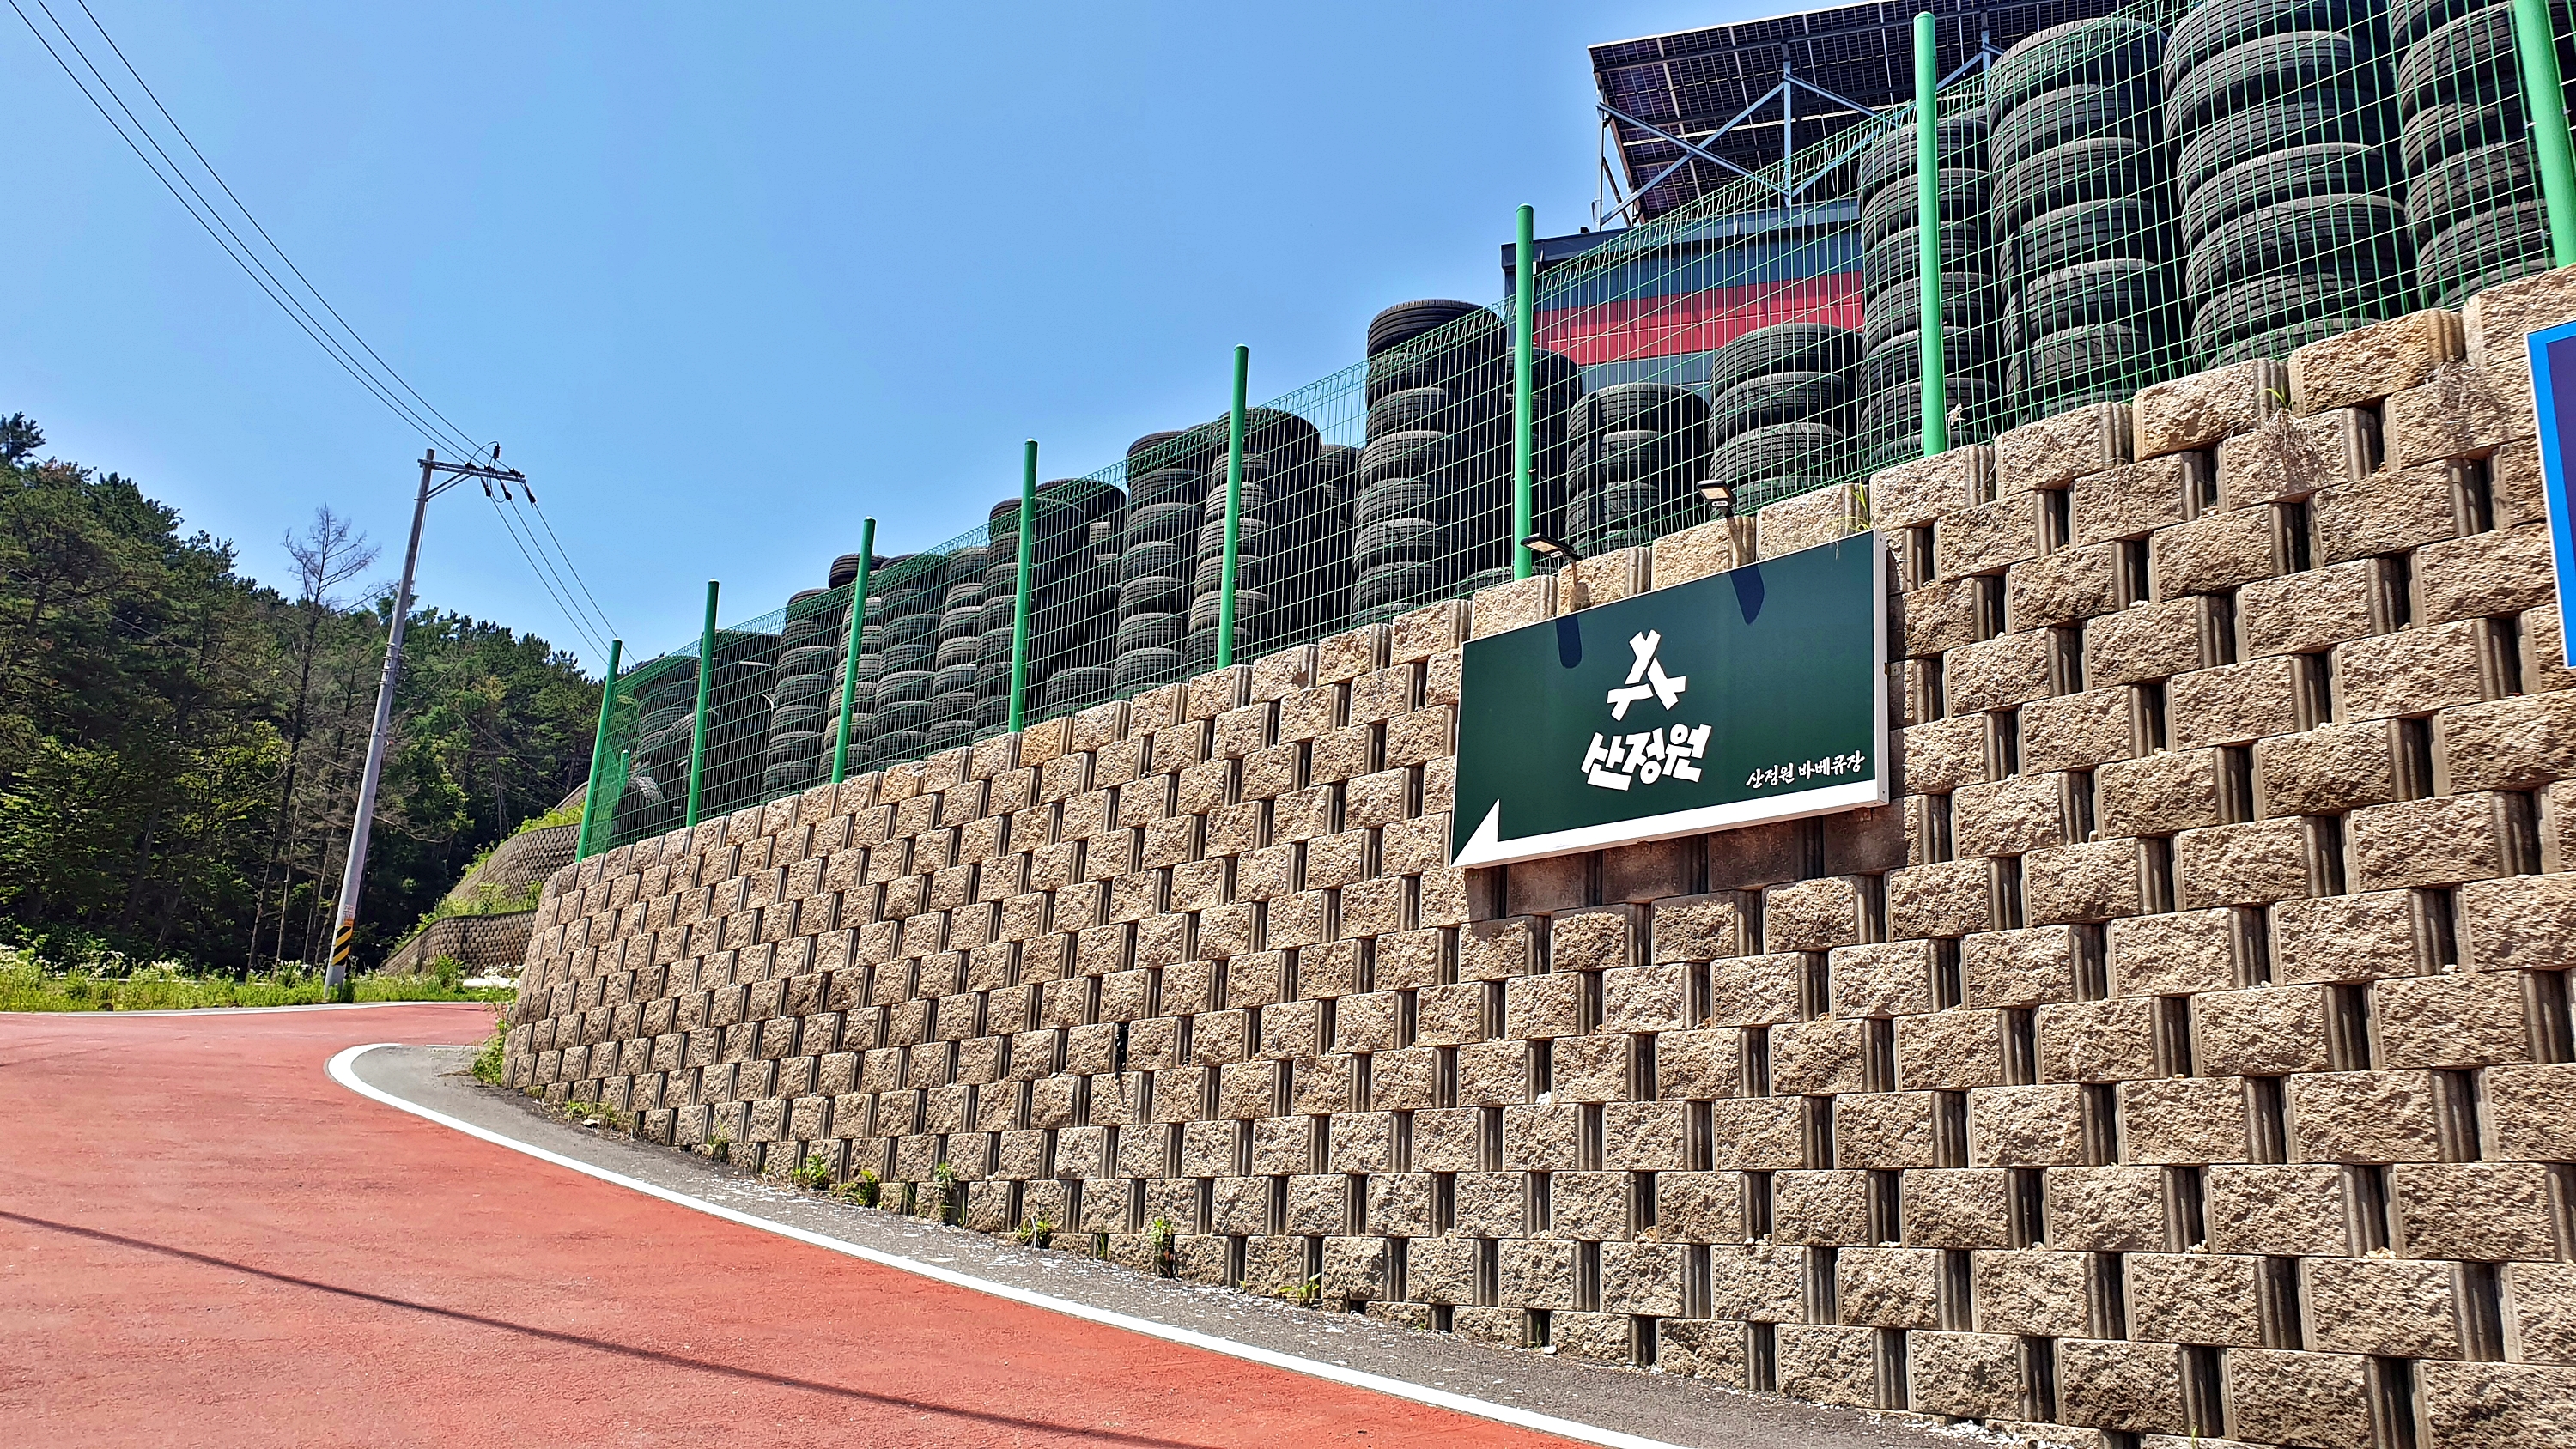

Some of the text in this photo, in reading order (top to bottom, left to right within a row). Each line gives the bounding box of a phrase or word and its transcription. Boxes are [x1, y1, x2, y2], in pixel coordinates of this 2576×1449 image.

[1581, 723, 1712, 791] 산정원
[1745, 749, 1866, 789] 산정원 바베큐장
